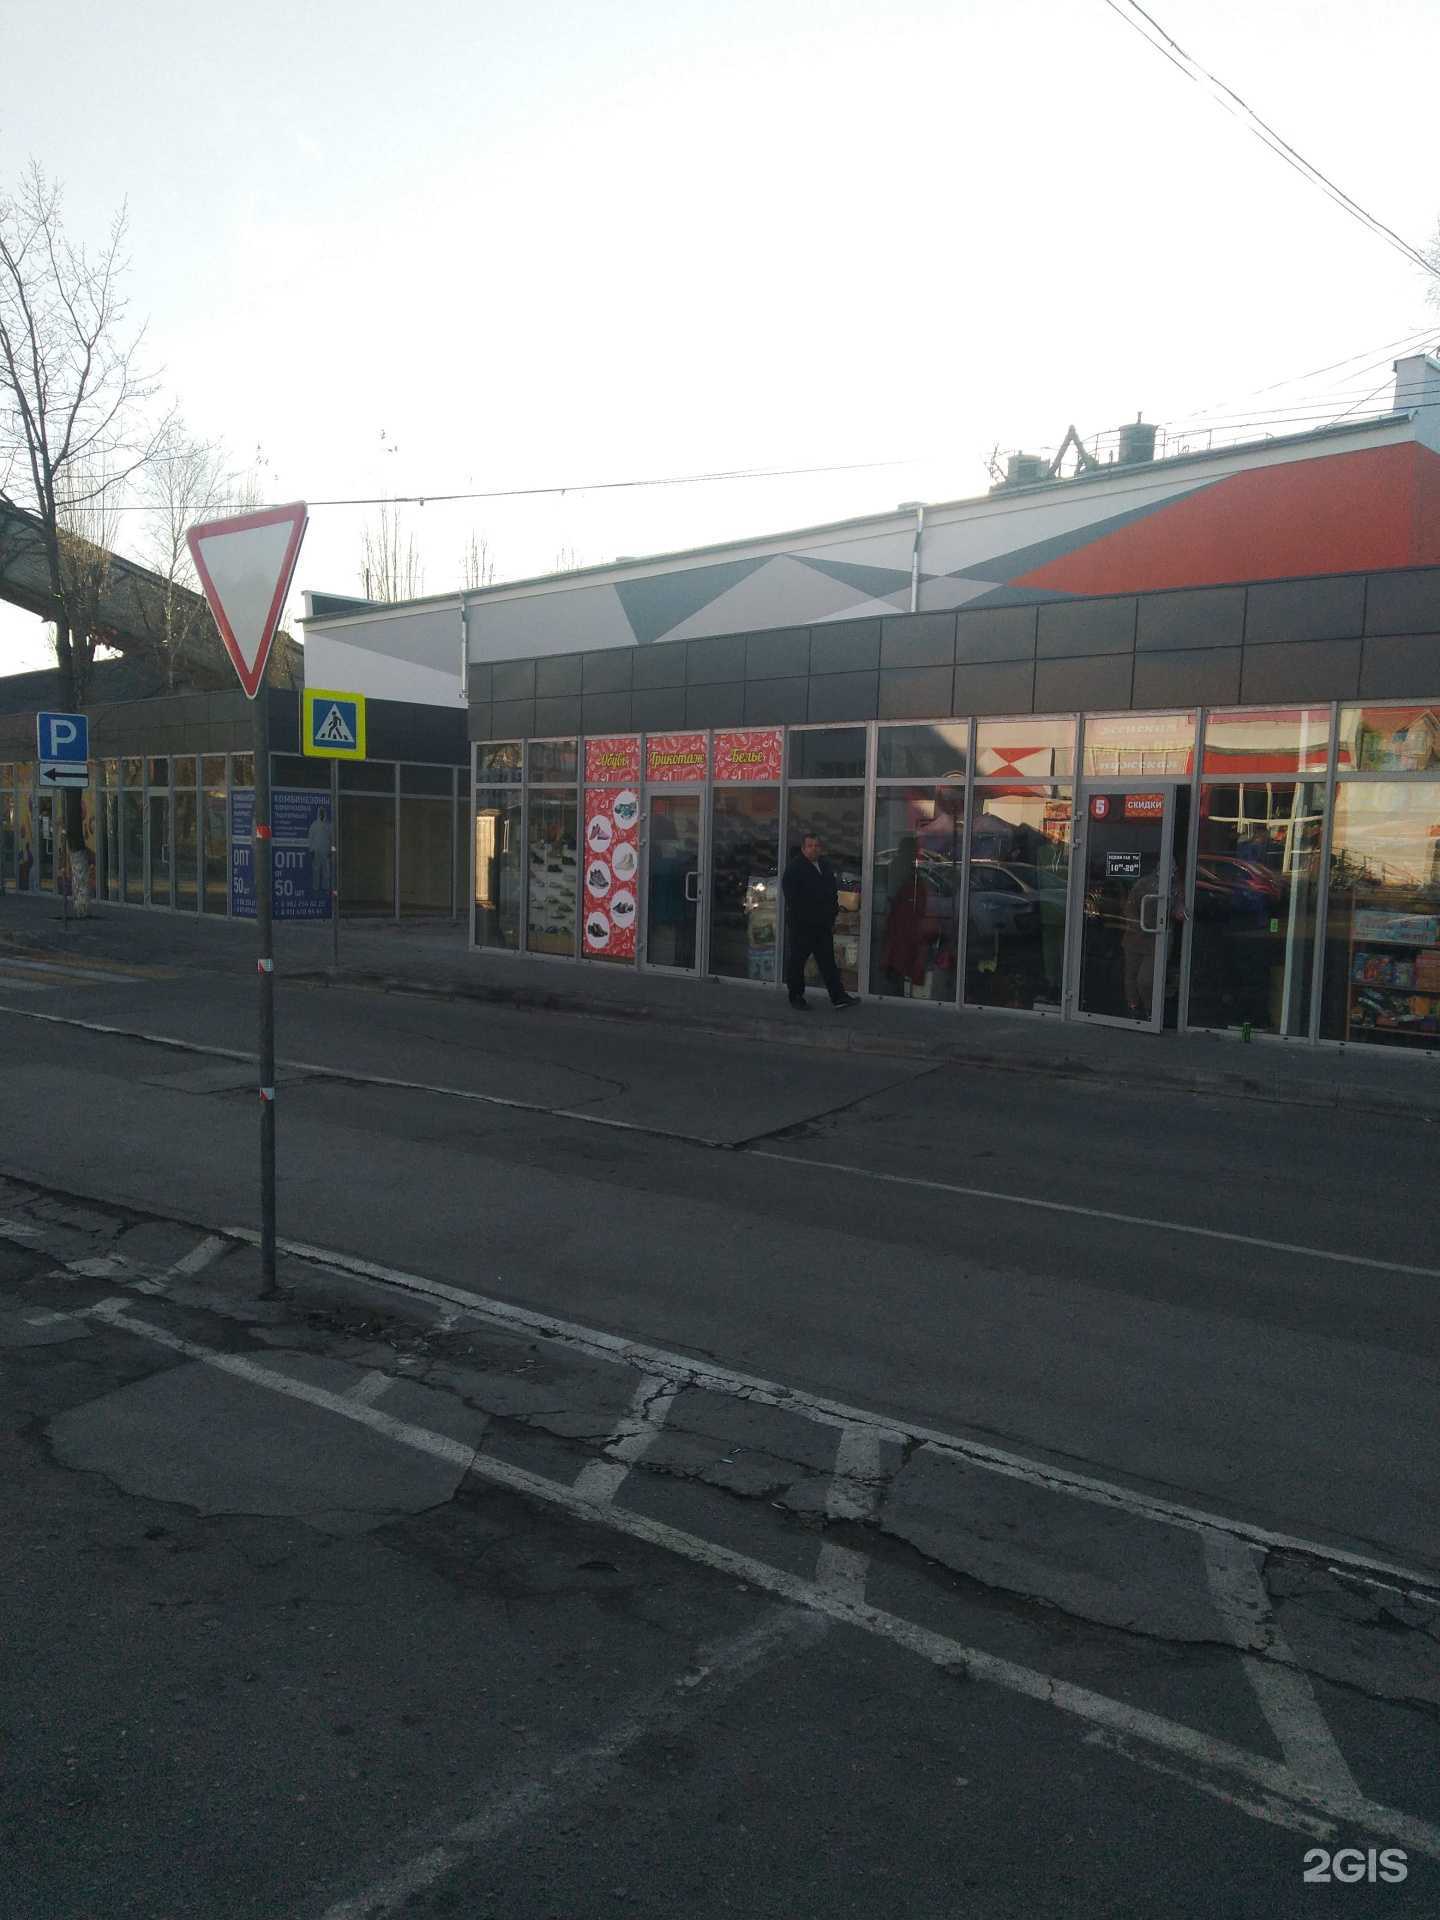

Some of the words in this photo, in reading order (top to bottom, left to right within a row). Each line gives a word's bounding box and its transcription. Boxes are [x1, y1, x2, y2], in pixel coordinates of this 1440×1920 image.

[50, 719, 77, 756] P
[649, 752, 705, 768] Трикотаж
[732, 749, 763, 763] Белье
[1095, 800, 1105, 815] 5
[1127, 801, 1162, 810] СКИДКИ
[233, 849, 250, 867] ОПТ
[274, 851, 306, 869] ОПТ
[233, 877, 244, 894] 50
[274, 879, 294, 896] 50
